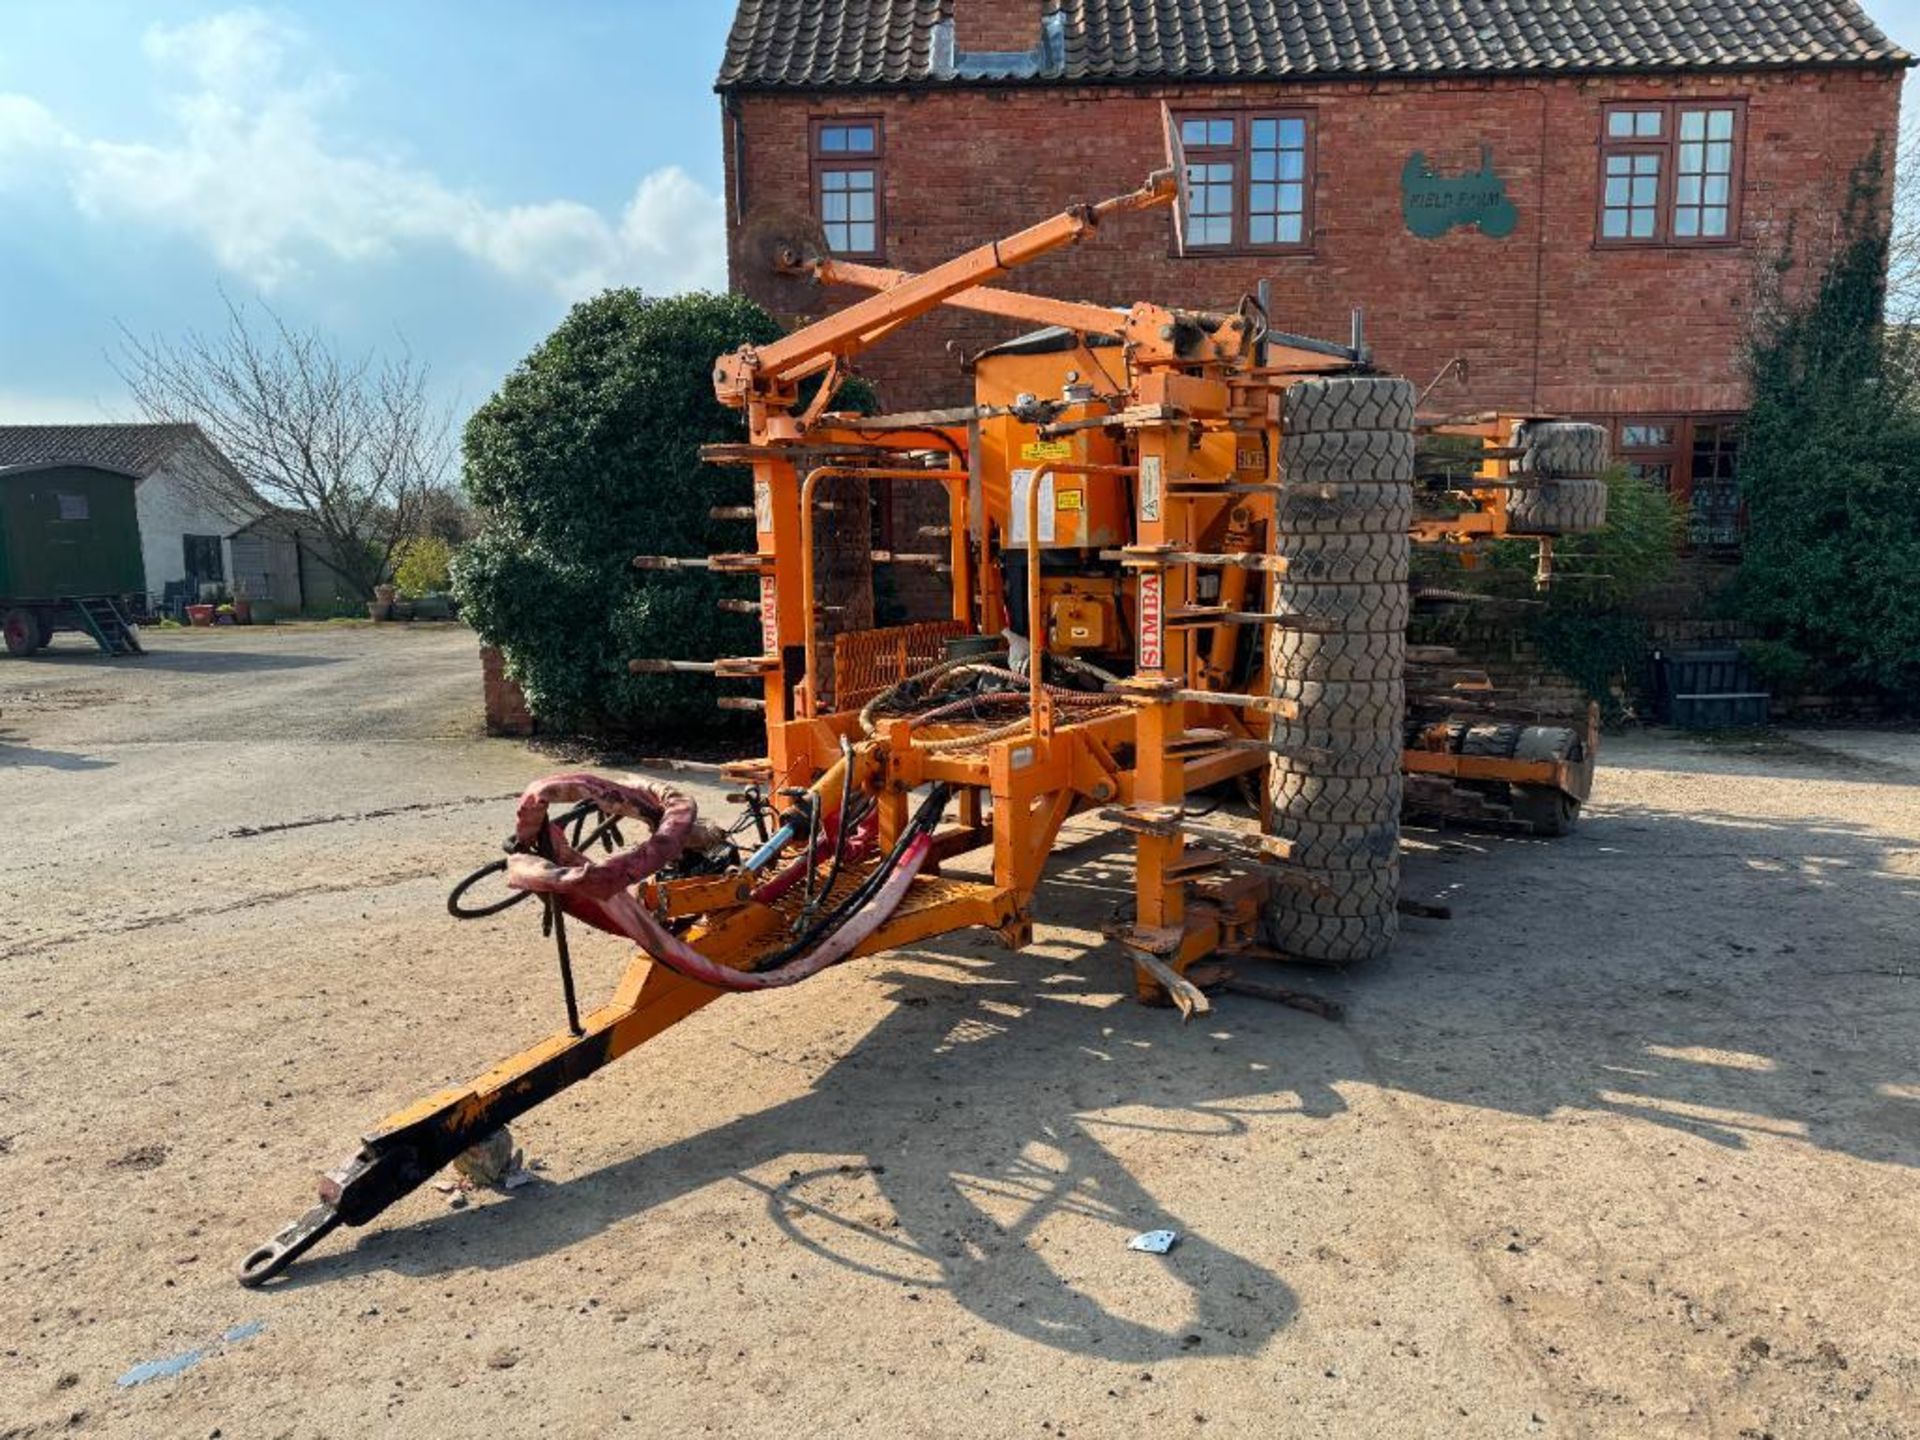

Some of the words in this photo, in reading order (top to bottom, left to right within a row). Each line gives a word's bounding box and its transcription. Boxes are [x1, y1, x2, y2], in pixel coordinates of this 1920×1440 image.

[1410, 192, 1453, 208] FIELD
[1455, 191, 1500, 208] FARM
[763, 578, 776, 649] SIMBA
[1141, 575, 1158, 667] SIMBA
